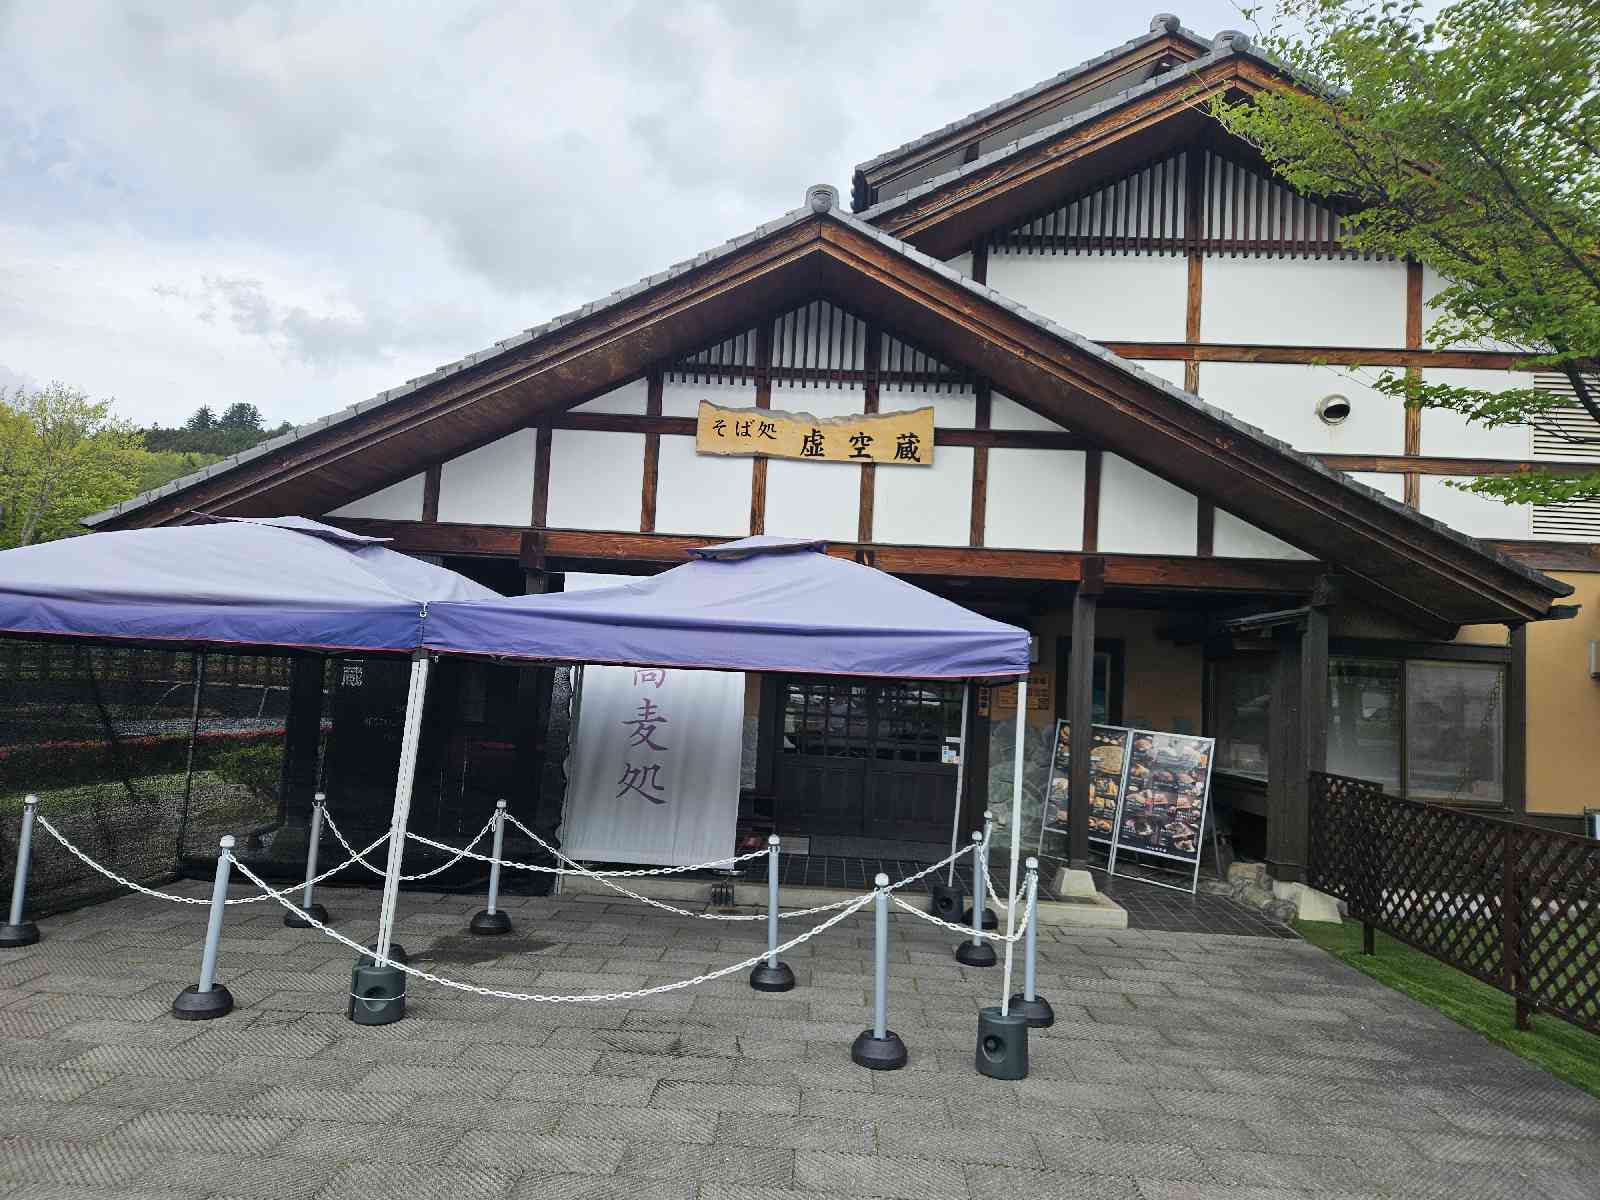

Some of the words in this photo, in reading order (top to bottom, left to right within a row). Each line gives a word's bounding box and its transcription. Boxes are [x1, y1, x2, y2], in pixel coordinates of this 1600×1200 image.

[712, 419, 777, 440] そば処
[799, 428, 921, 463] 虚空蔵
